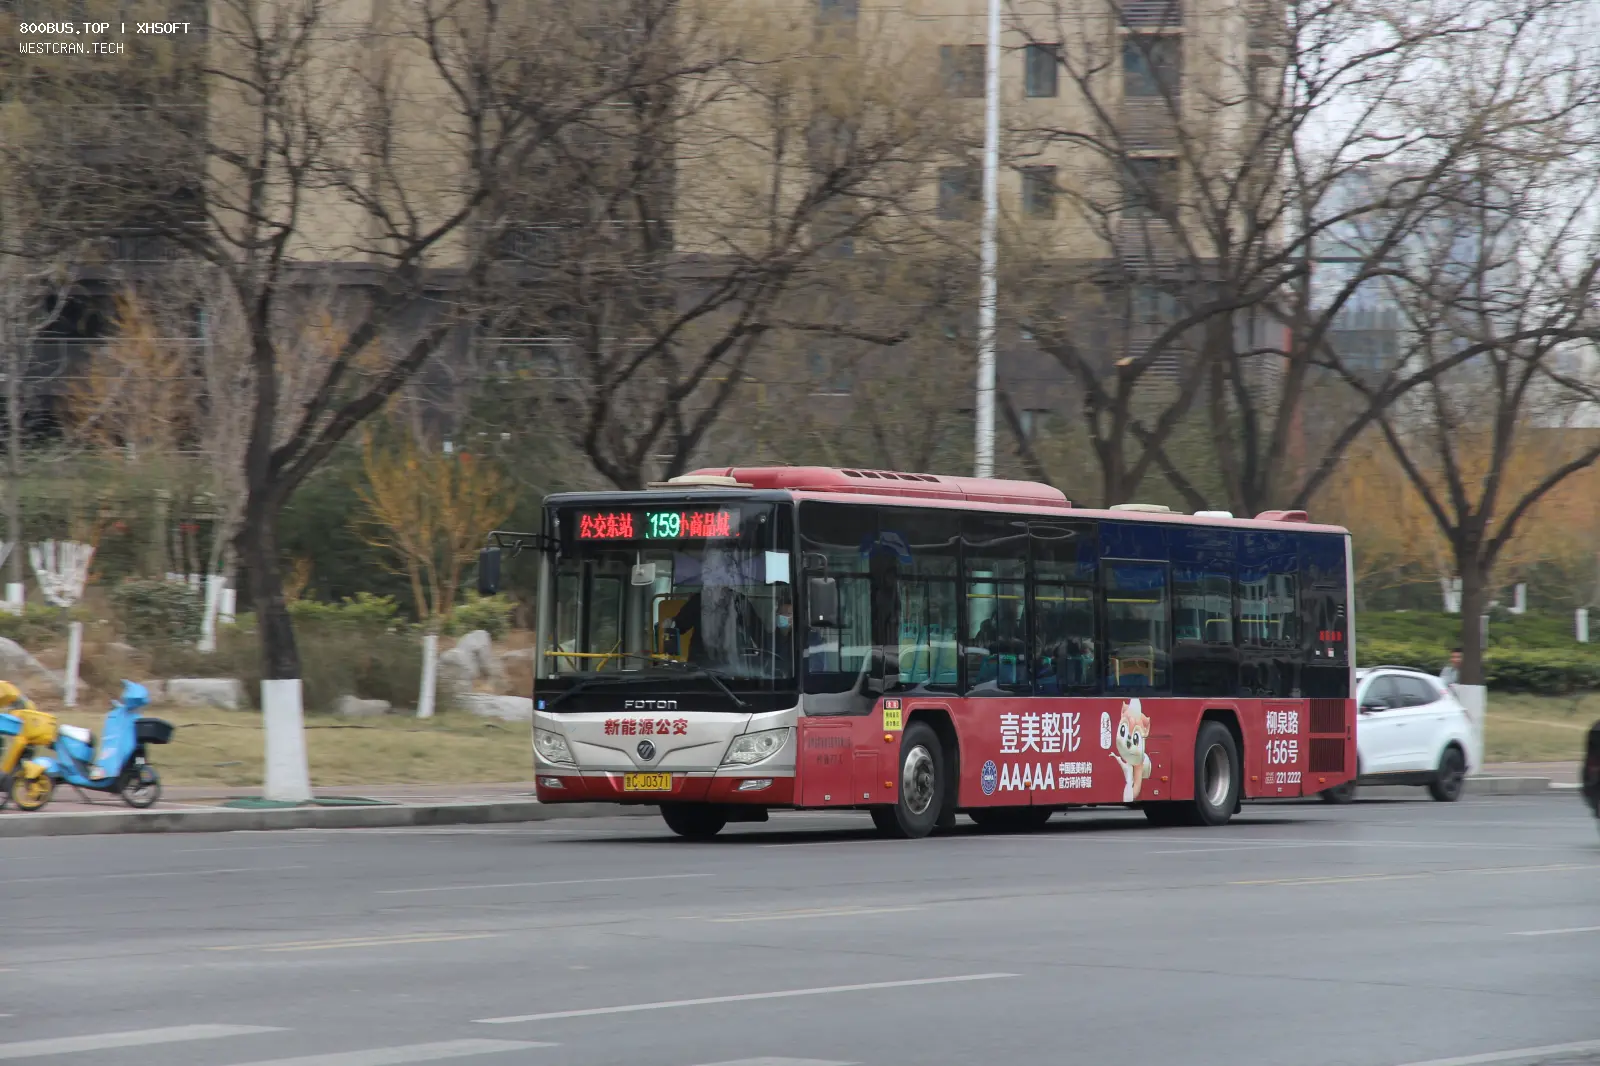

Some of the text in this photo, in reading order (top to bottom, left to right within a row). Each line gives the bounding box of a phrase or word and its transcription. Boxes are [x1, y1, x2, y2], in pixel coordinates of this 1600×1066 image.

[580, 513, 633, 538] 公交东站
[650, 513, 680, 537] 159
[624, 700, 678, 710] FOTON
[604, 719, 689, 736] 新能源公交
[1000, 712, 1081, 753] 壹美整形
[1266, 710, 1298, 735] 柳泉路
[1266, 740, 1298, 764] 156号
[999, 762, 1055, 791] AAAAA
